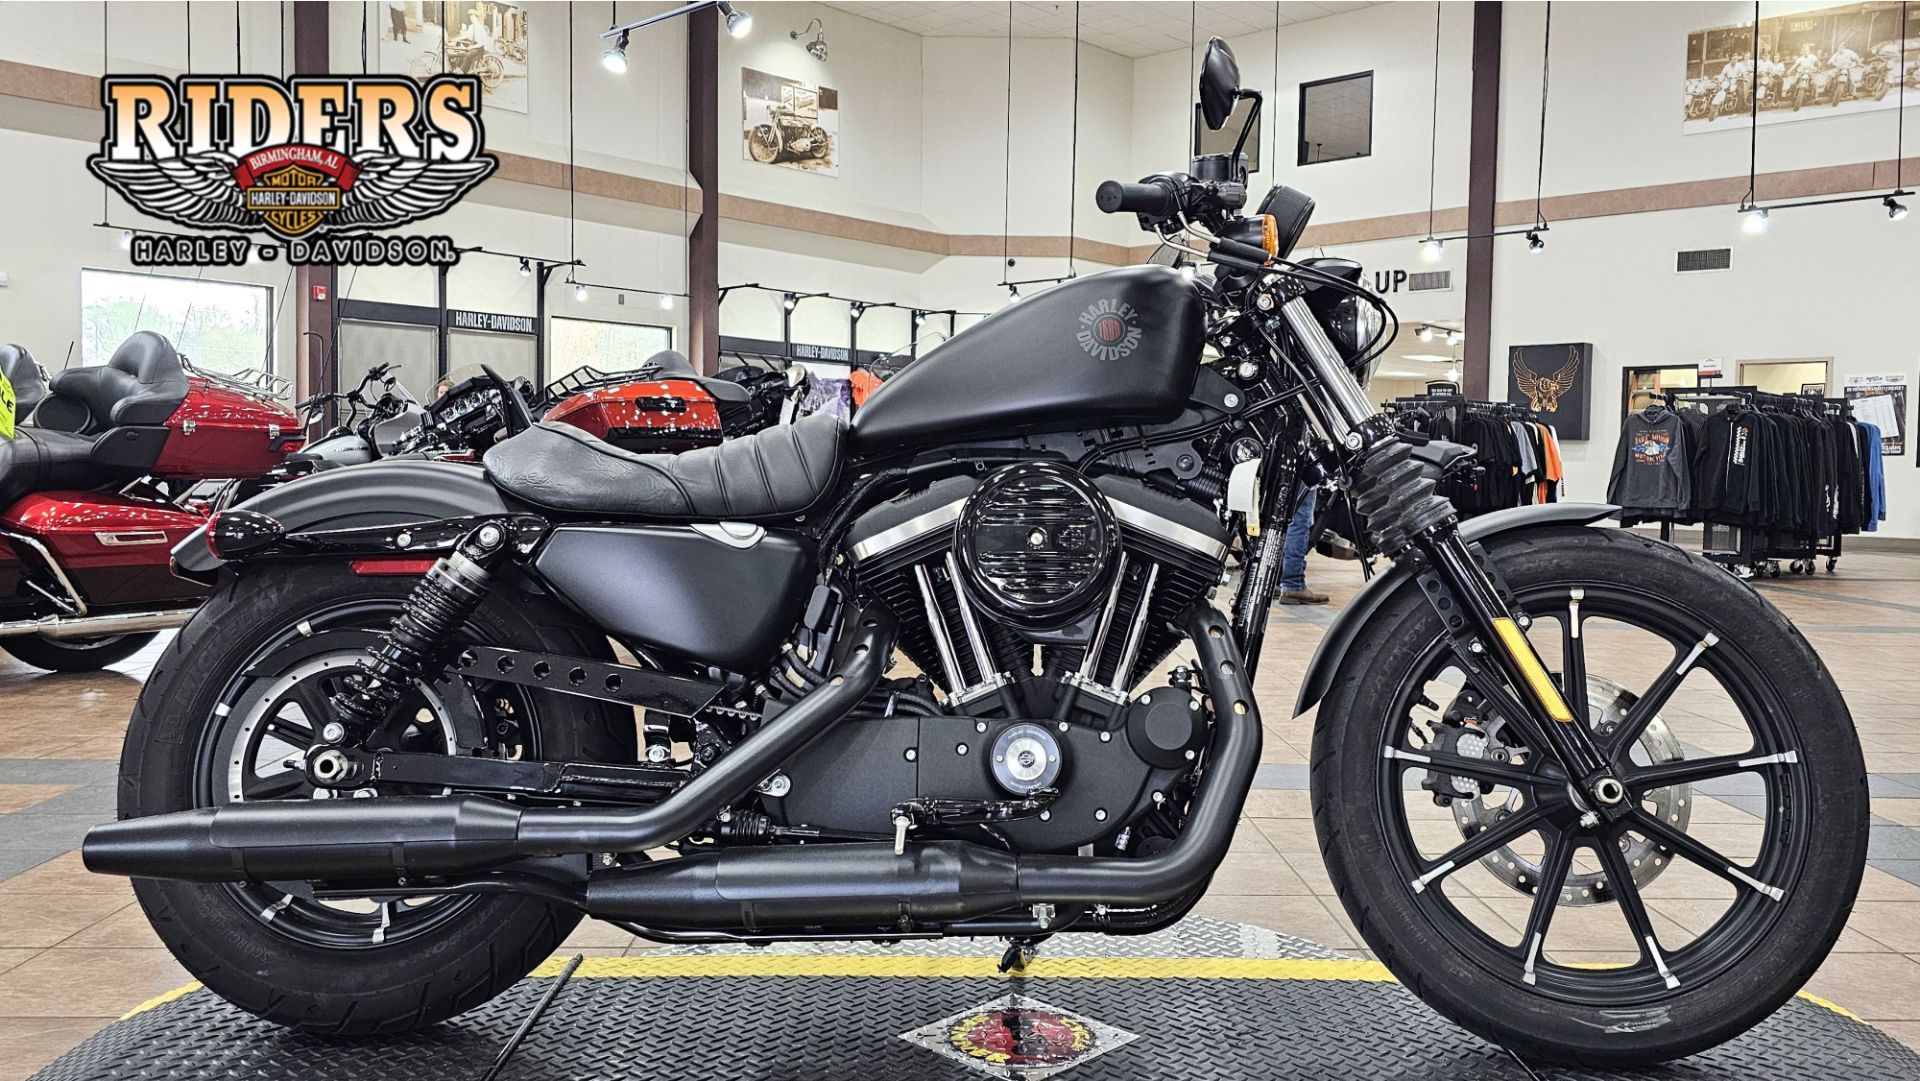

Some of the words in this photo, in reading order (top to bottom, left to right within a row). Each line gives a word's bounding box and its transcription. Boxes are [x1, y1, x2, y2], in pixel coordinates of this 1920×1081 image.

[1375, 268, 1408, 295] UP
[455, 310, 535, 333] HARLEY-DAVIDSON
[1078, 298, 1139, 325] HARLEY
[796, 344, 849, 361] HARLEY-DAVIDSON
[1076, 325, 1142, 361] DAVIDSON
